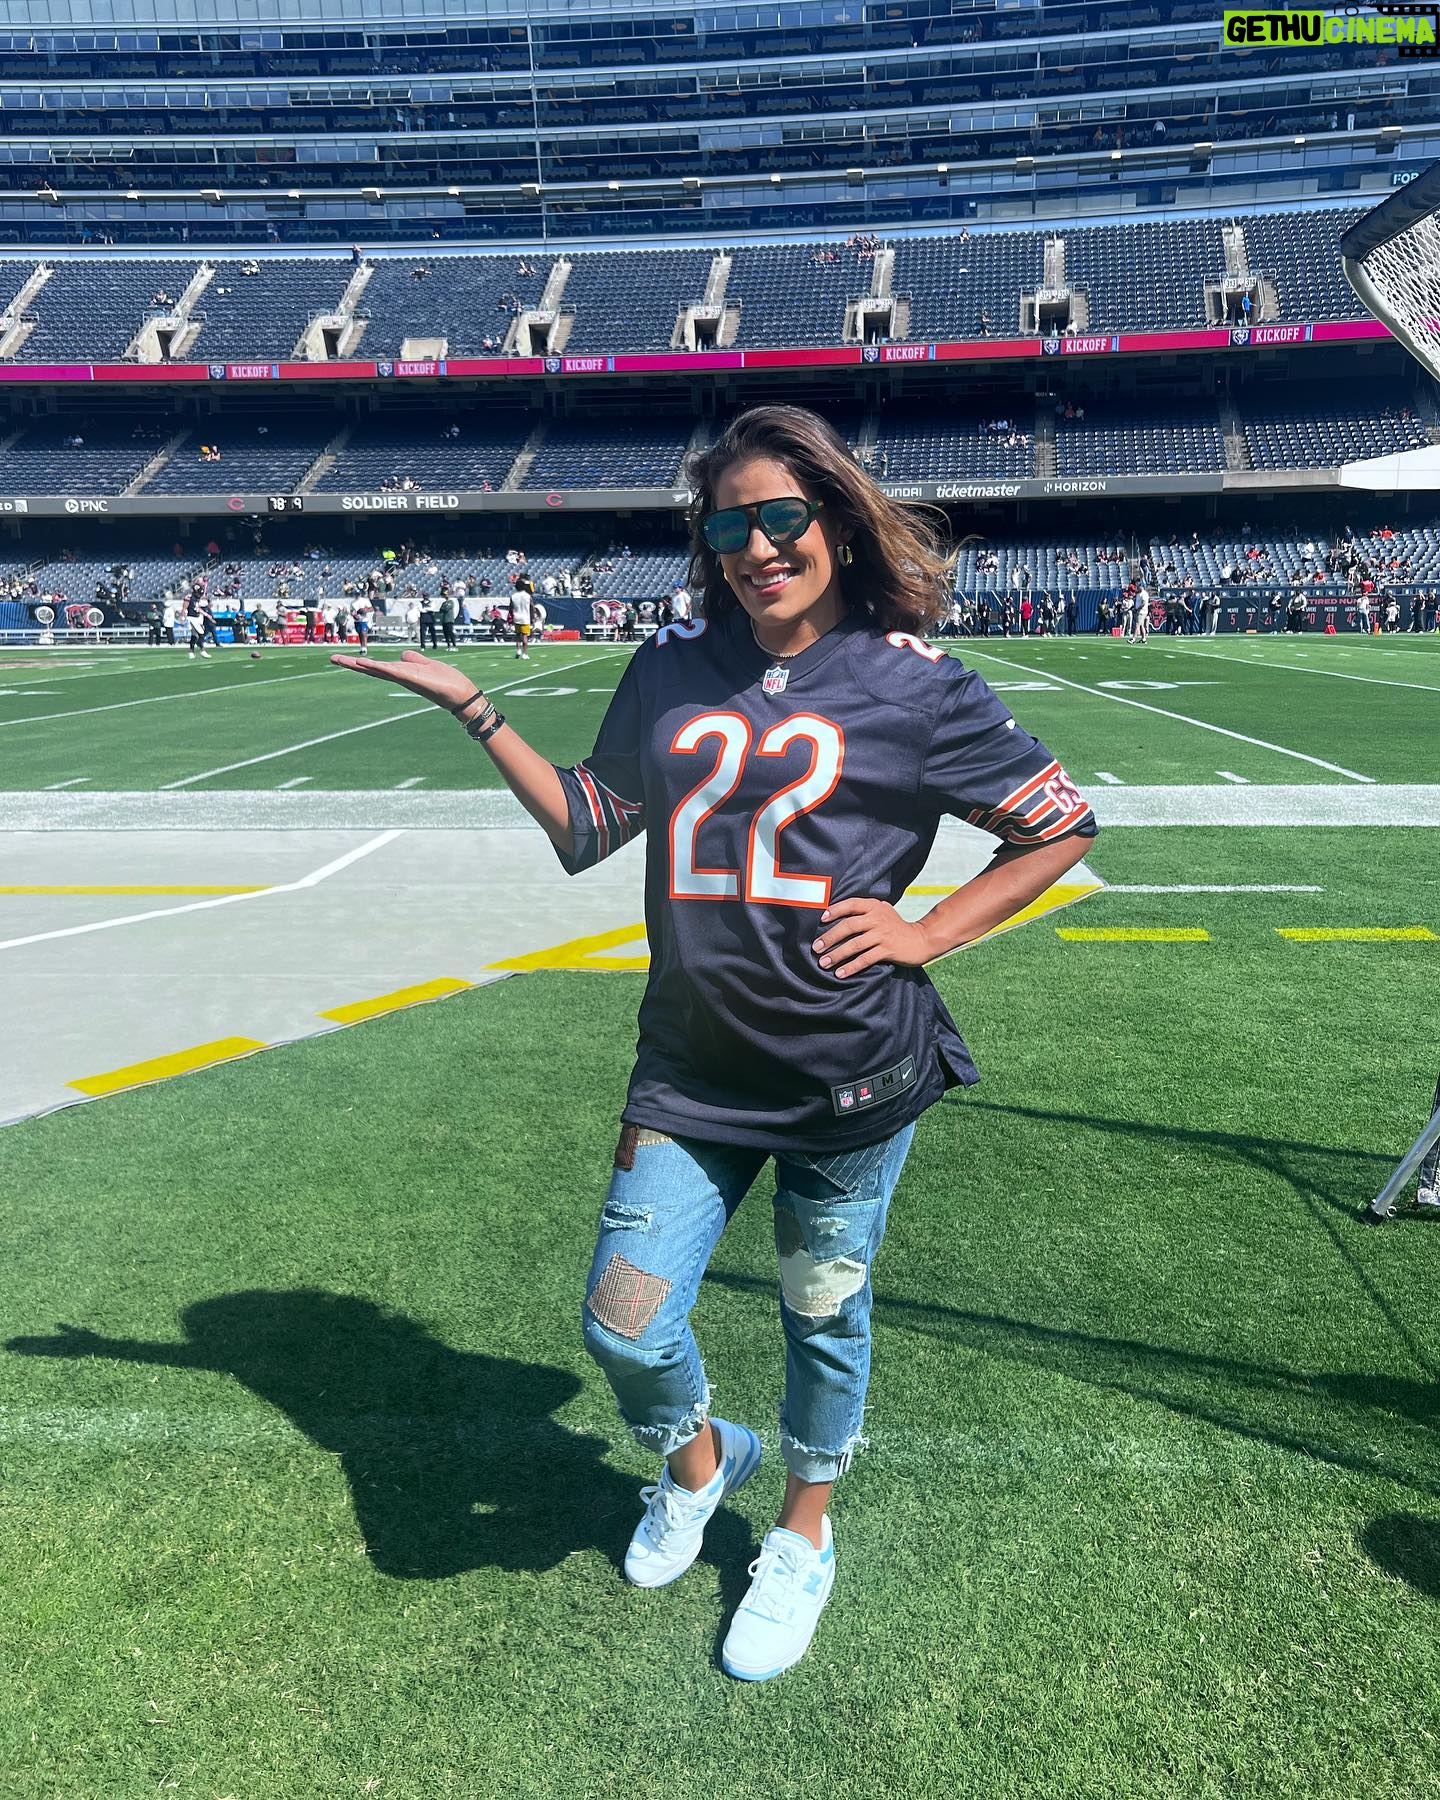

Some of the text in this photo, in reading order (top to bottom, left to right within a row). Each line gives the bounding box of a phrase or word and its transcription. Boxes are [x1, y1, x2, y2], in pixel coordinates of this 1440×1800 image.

[1255, 327, 1299, 343] KICKOFF
[1066, 338, 1107, 353] KICKOFF
[886, 347, 925, 361] KICKOFF
[398, 362, 436, 376] KICKOFF
[566, 358, 603, 371] KICKOFF
[231, 365, 269, 379] KICKOFF
[936, 484, 1021, 499] ticketmaster
[1054, 482, 1106, 493] HORIZON
[80, 500, 108, 512] PNC
[342, 495, 459, 510] SOLDIER FIELD
[765, 678, 784, 690] NFL
[669, 711, 845, 909] 22
[881, 1073, 895, 1087] M
